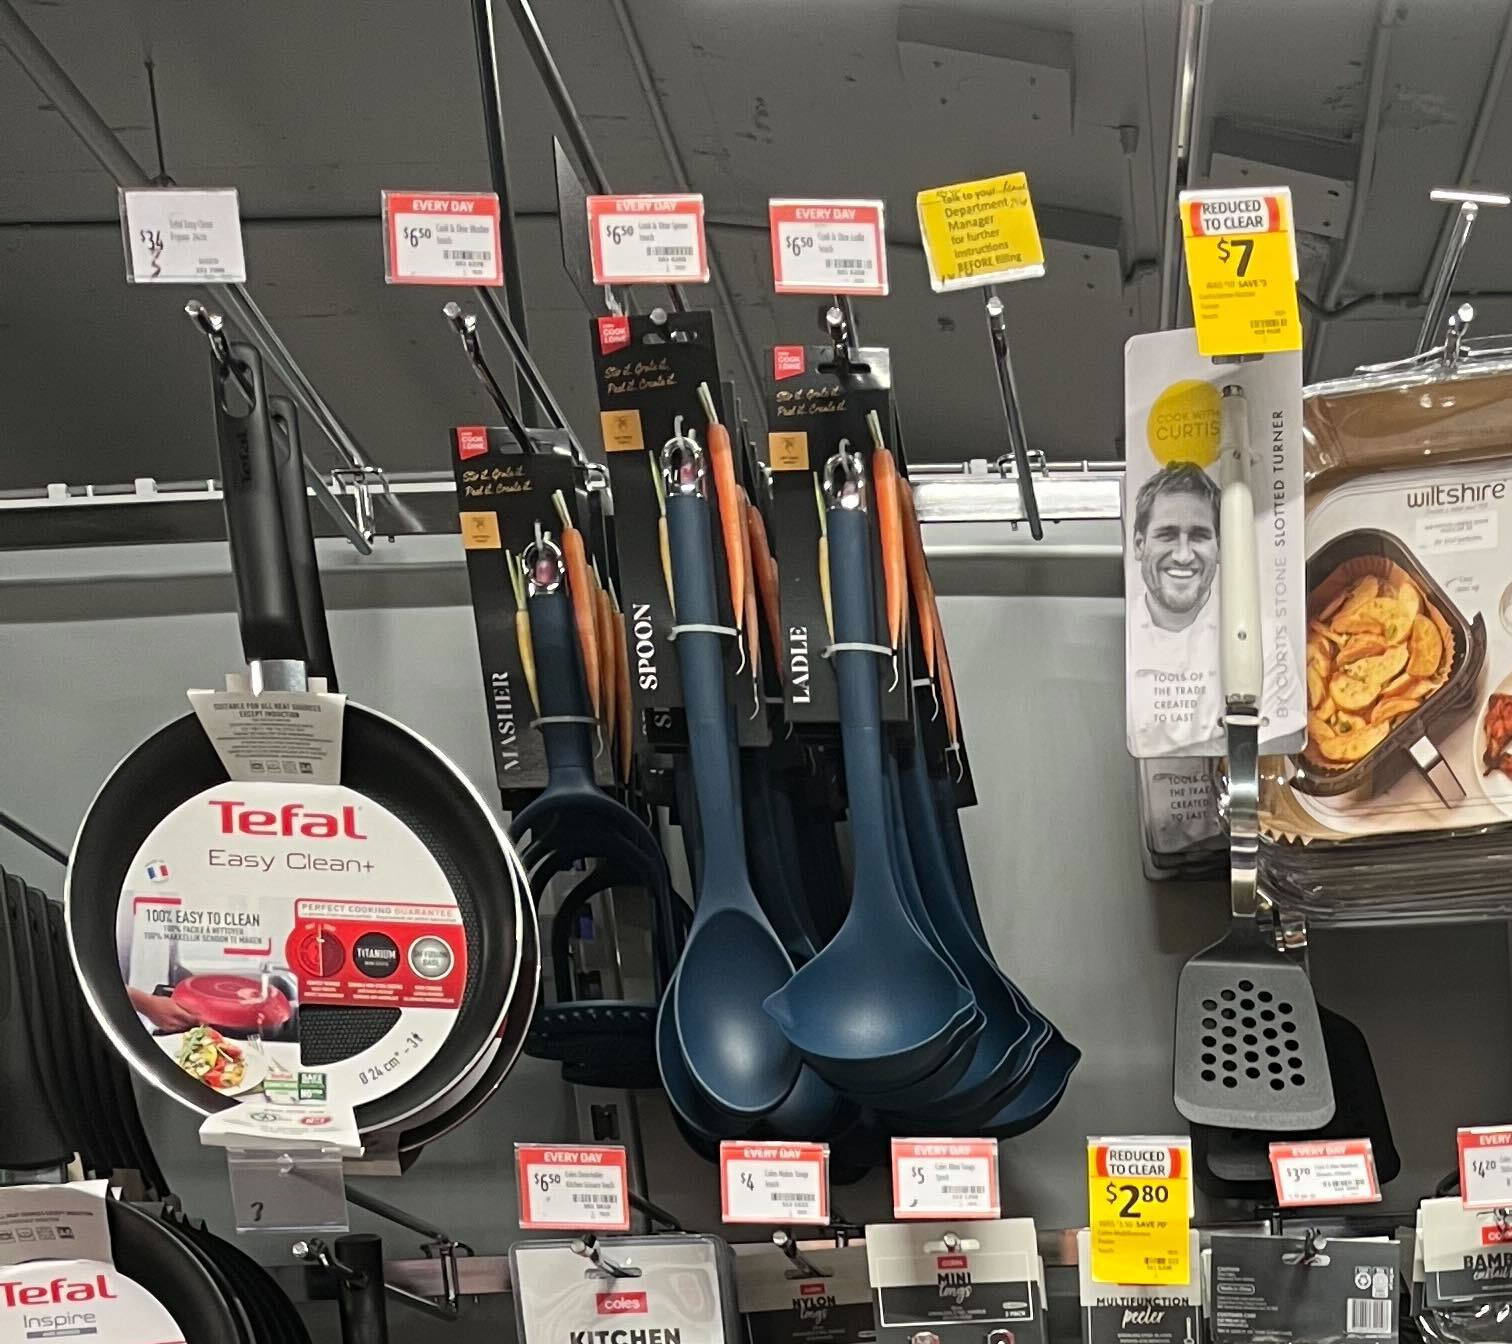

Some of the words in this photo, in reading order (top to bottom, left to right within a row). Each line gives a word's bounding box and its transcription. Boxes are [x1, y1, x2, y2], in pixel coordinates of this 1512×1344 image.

[412, 200, 449, 212] EVERY
[451, 200, 474, 212] DAY
[1202, 200, 1261, 215] REDUCED
[1204, 217, 1223, 231] TO
[1225, 215, 1264, 230] CLEAR
[1217, 239, 1254, 278] $7
[1156, 422, 1221, 440] CURTIS
[1272, 411, 1284, 473] TURNER
[1406, 479, 1506, 510] wiltshire
[1274, 480, 1285, 546] SLOTTED
[633, 604, 658, 691] SPOON
[792, 625, 812, 704] LADLE
[492, 671, 521, 772] MASHER
[208, 800, 369, 841] Tefal
[208, 848, 276, 873] Easy
[285, 851, 375, 873] Clean+
[176, 910, 204, 924] EASY
[207, 910, 221, 926] TO
[224, 911, 260, 927] CLEAN
[1109, 1149, 1165, 1163] REDUCED
[1109, 1163, 1125, 1175] TO
[1127, 1162, 1166, 1176] CLEAR
[740, 1171, 754, 1192] $4
[604, 1296, 640, 1311] coles
[22, 1310, 98, 1333] Inspire
[1121, 1306, 1165, 1329] peeler
